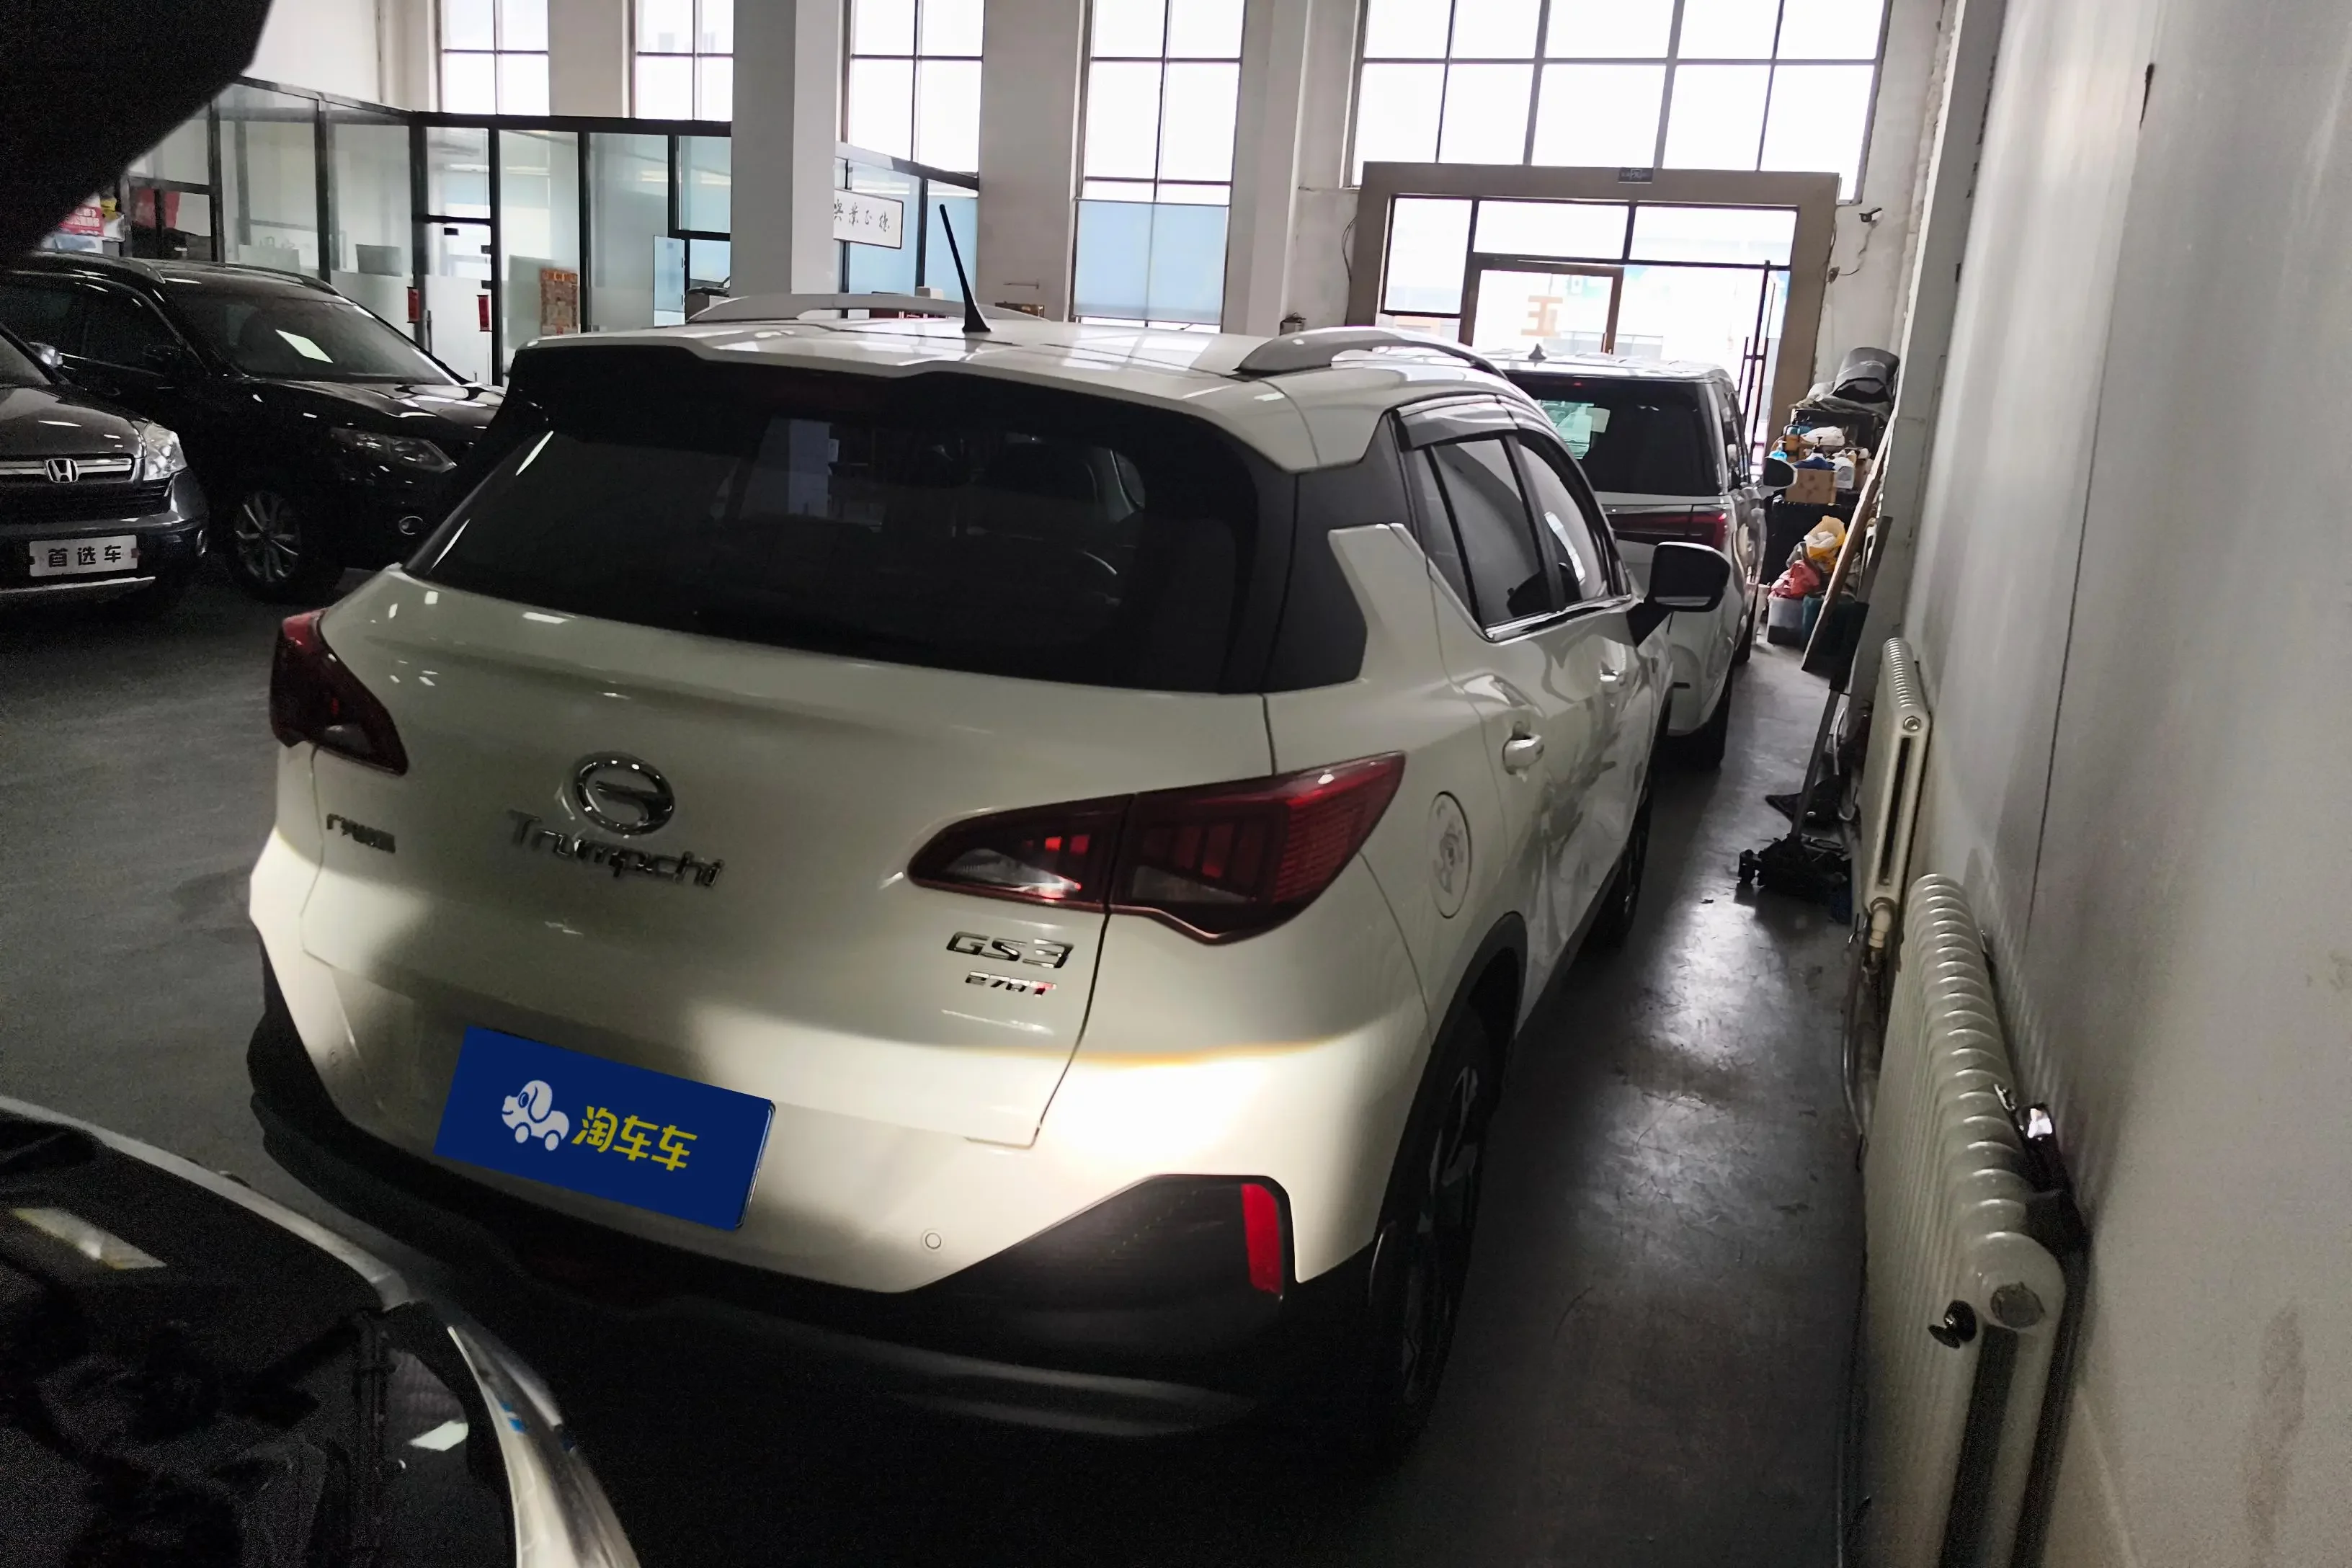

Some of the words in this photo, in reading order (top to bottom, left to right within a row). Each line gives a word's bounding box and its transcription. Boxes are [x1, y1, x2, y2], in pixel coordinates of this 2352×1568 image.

[48, 545, 122, 568] 首选车
[508, 809, 724, 887] Trumpchi
[946, 931, 1074, 968] GS3
